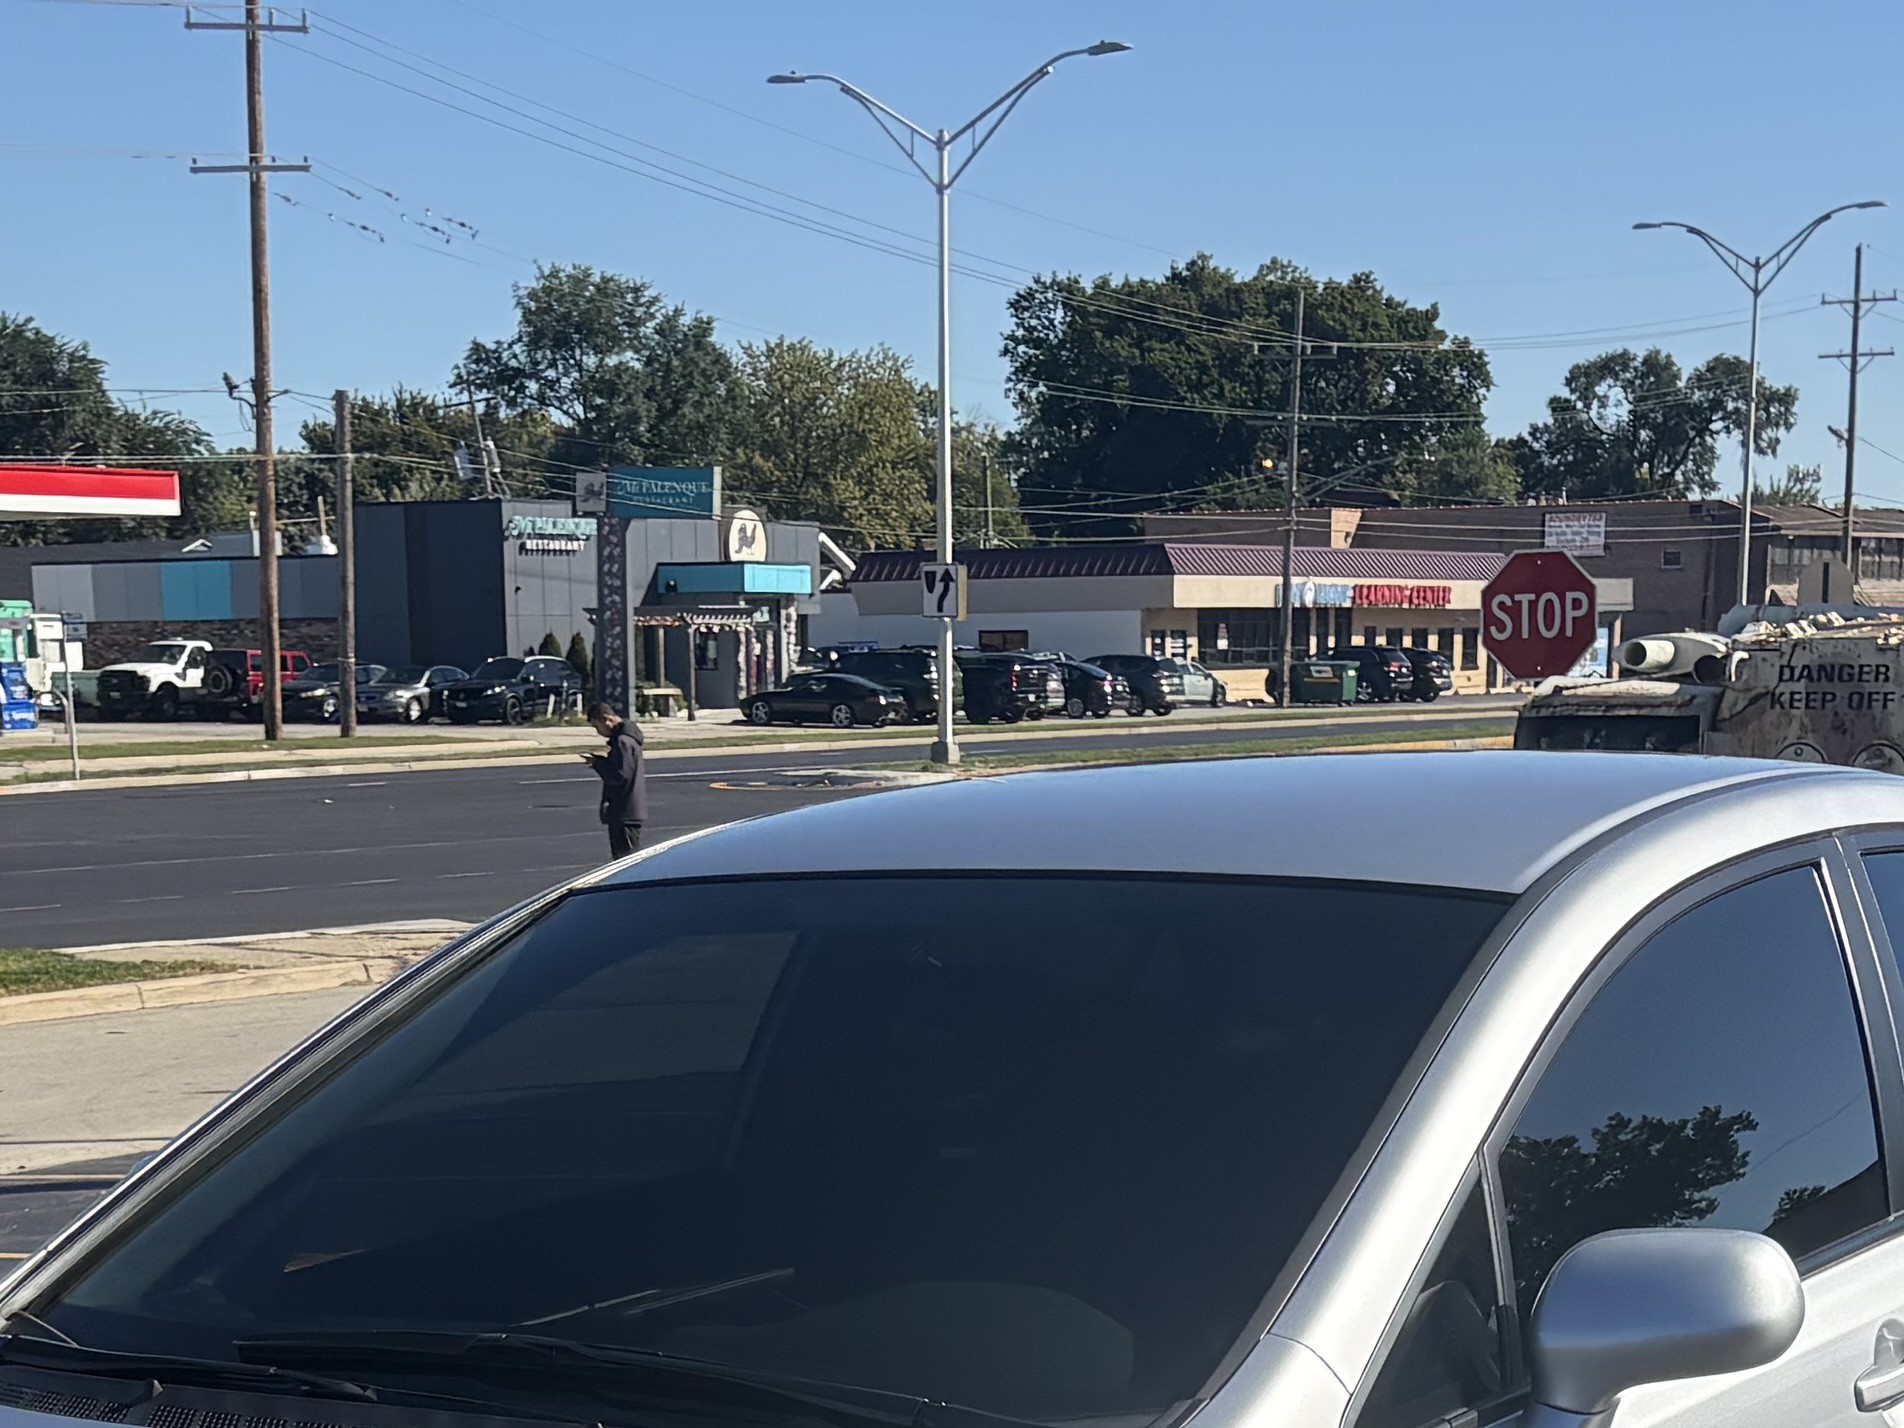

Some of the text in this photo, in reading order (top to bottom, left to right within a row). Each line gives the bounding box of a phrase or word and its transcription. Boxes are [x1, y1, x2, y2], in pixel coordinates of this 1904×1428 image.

[1489, 591, 1589, 641] STOP
[1779, 663, 1891, 683] DANGER
[1769, 691, 1897, 710] KEEP OFF
